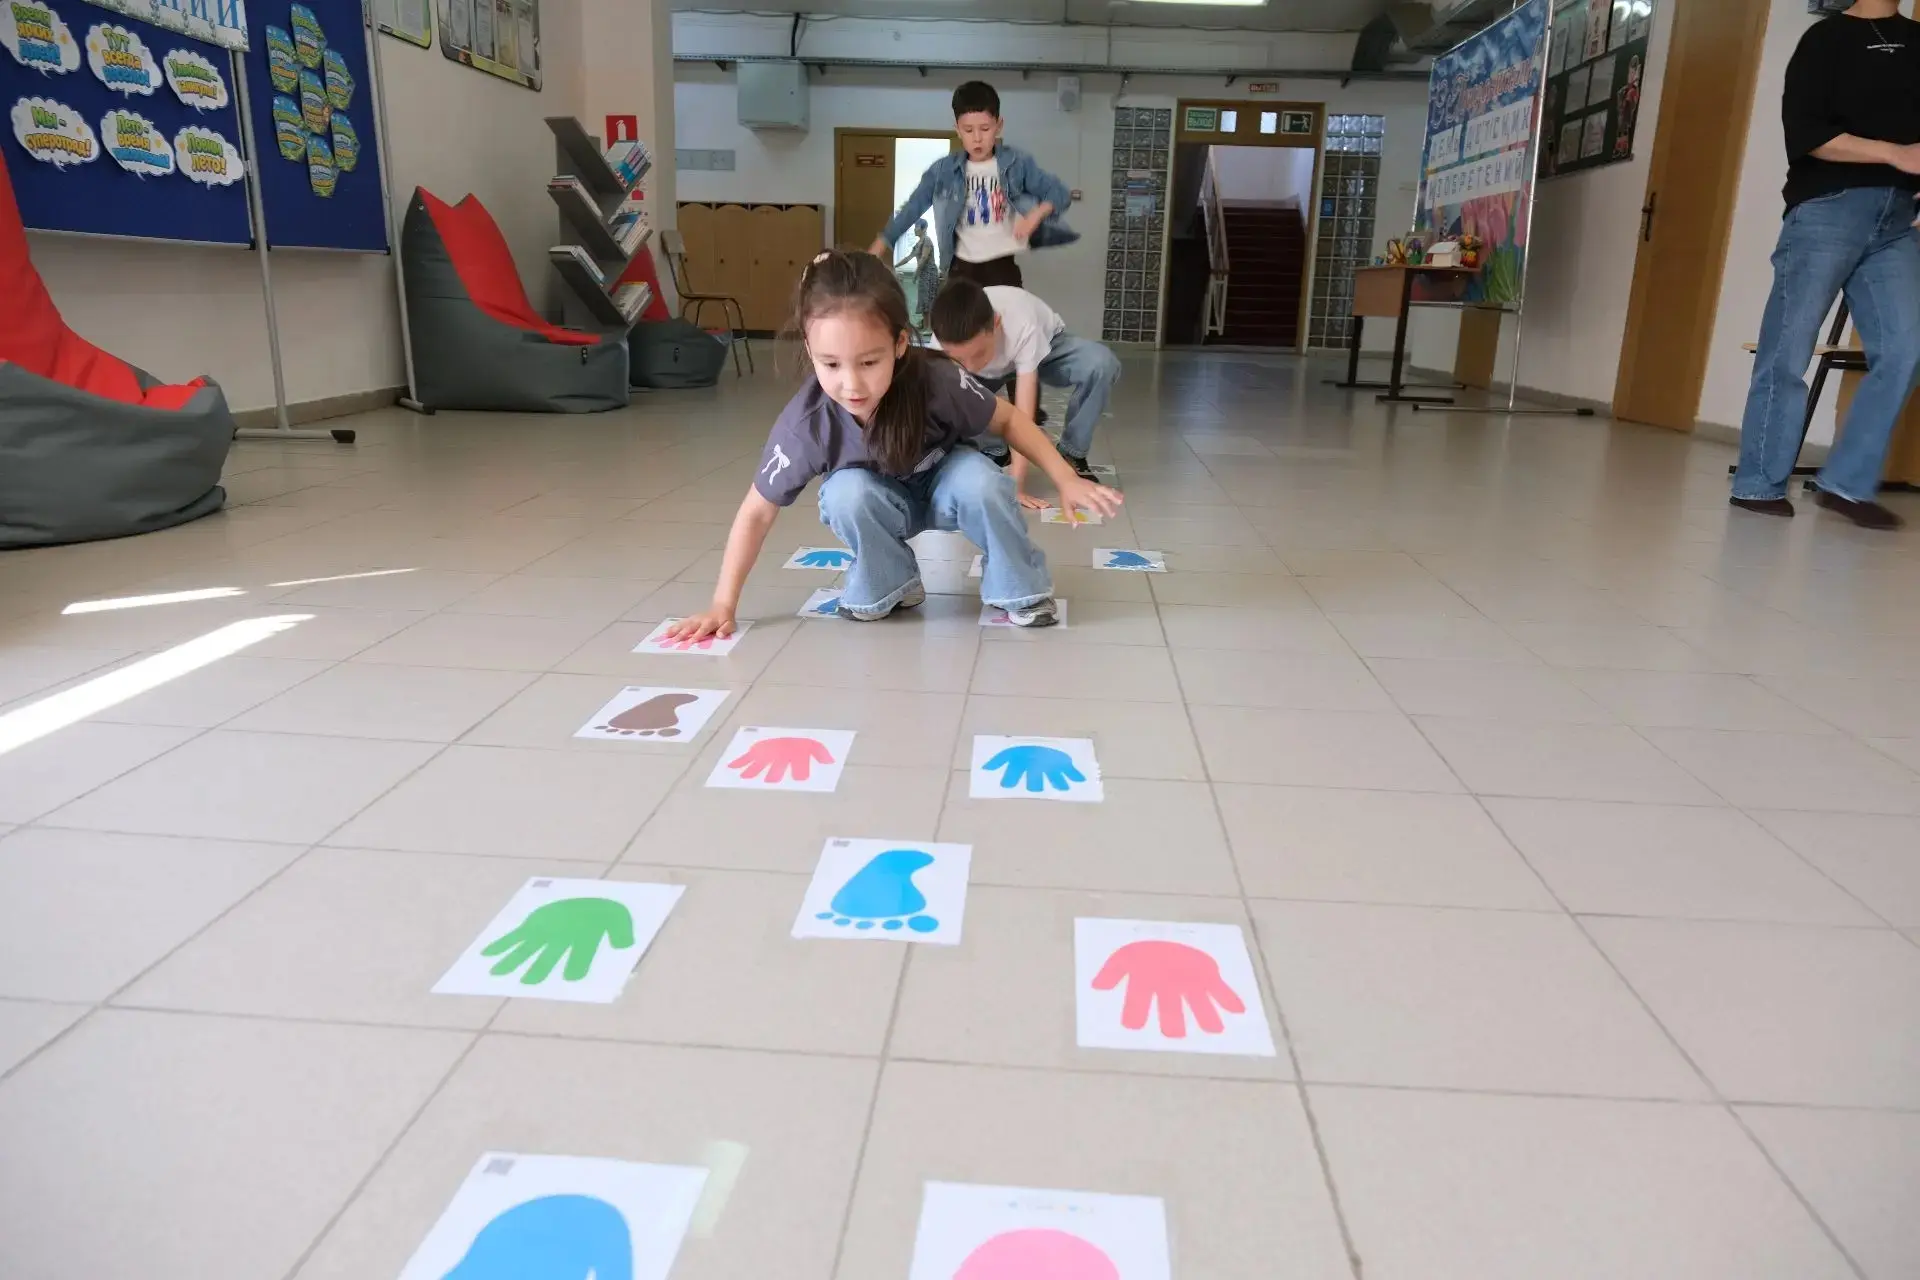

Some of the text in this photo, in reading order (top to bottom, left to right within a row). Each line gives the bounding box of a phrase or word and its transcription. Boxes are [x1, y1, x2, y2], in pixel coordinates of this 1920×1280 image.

[102, 49, 142, 71] всегда
[31, 106, 58, 130] Мы
[116, 114, 144, 135] Лето
[24, 132, 92, 158] суперотряд!
[116, 133, 151, 152] время
[191, 153, 227, 175] лето!
